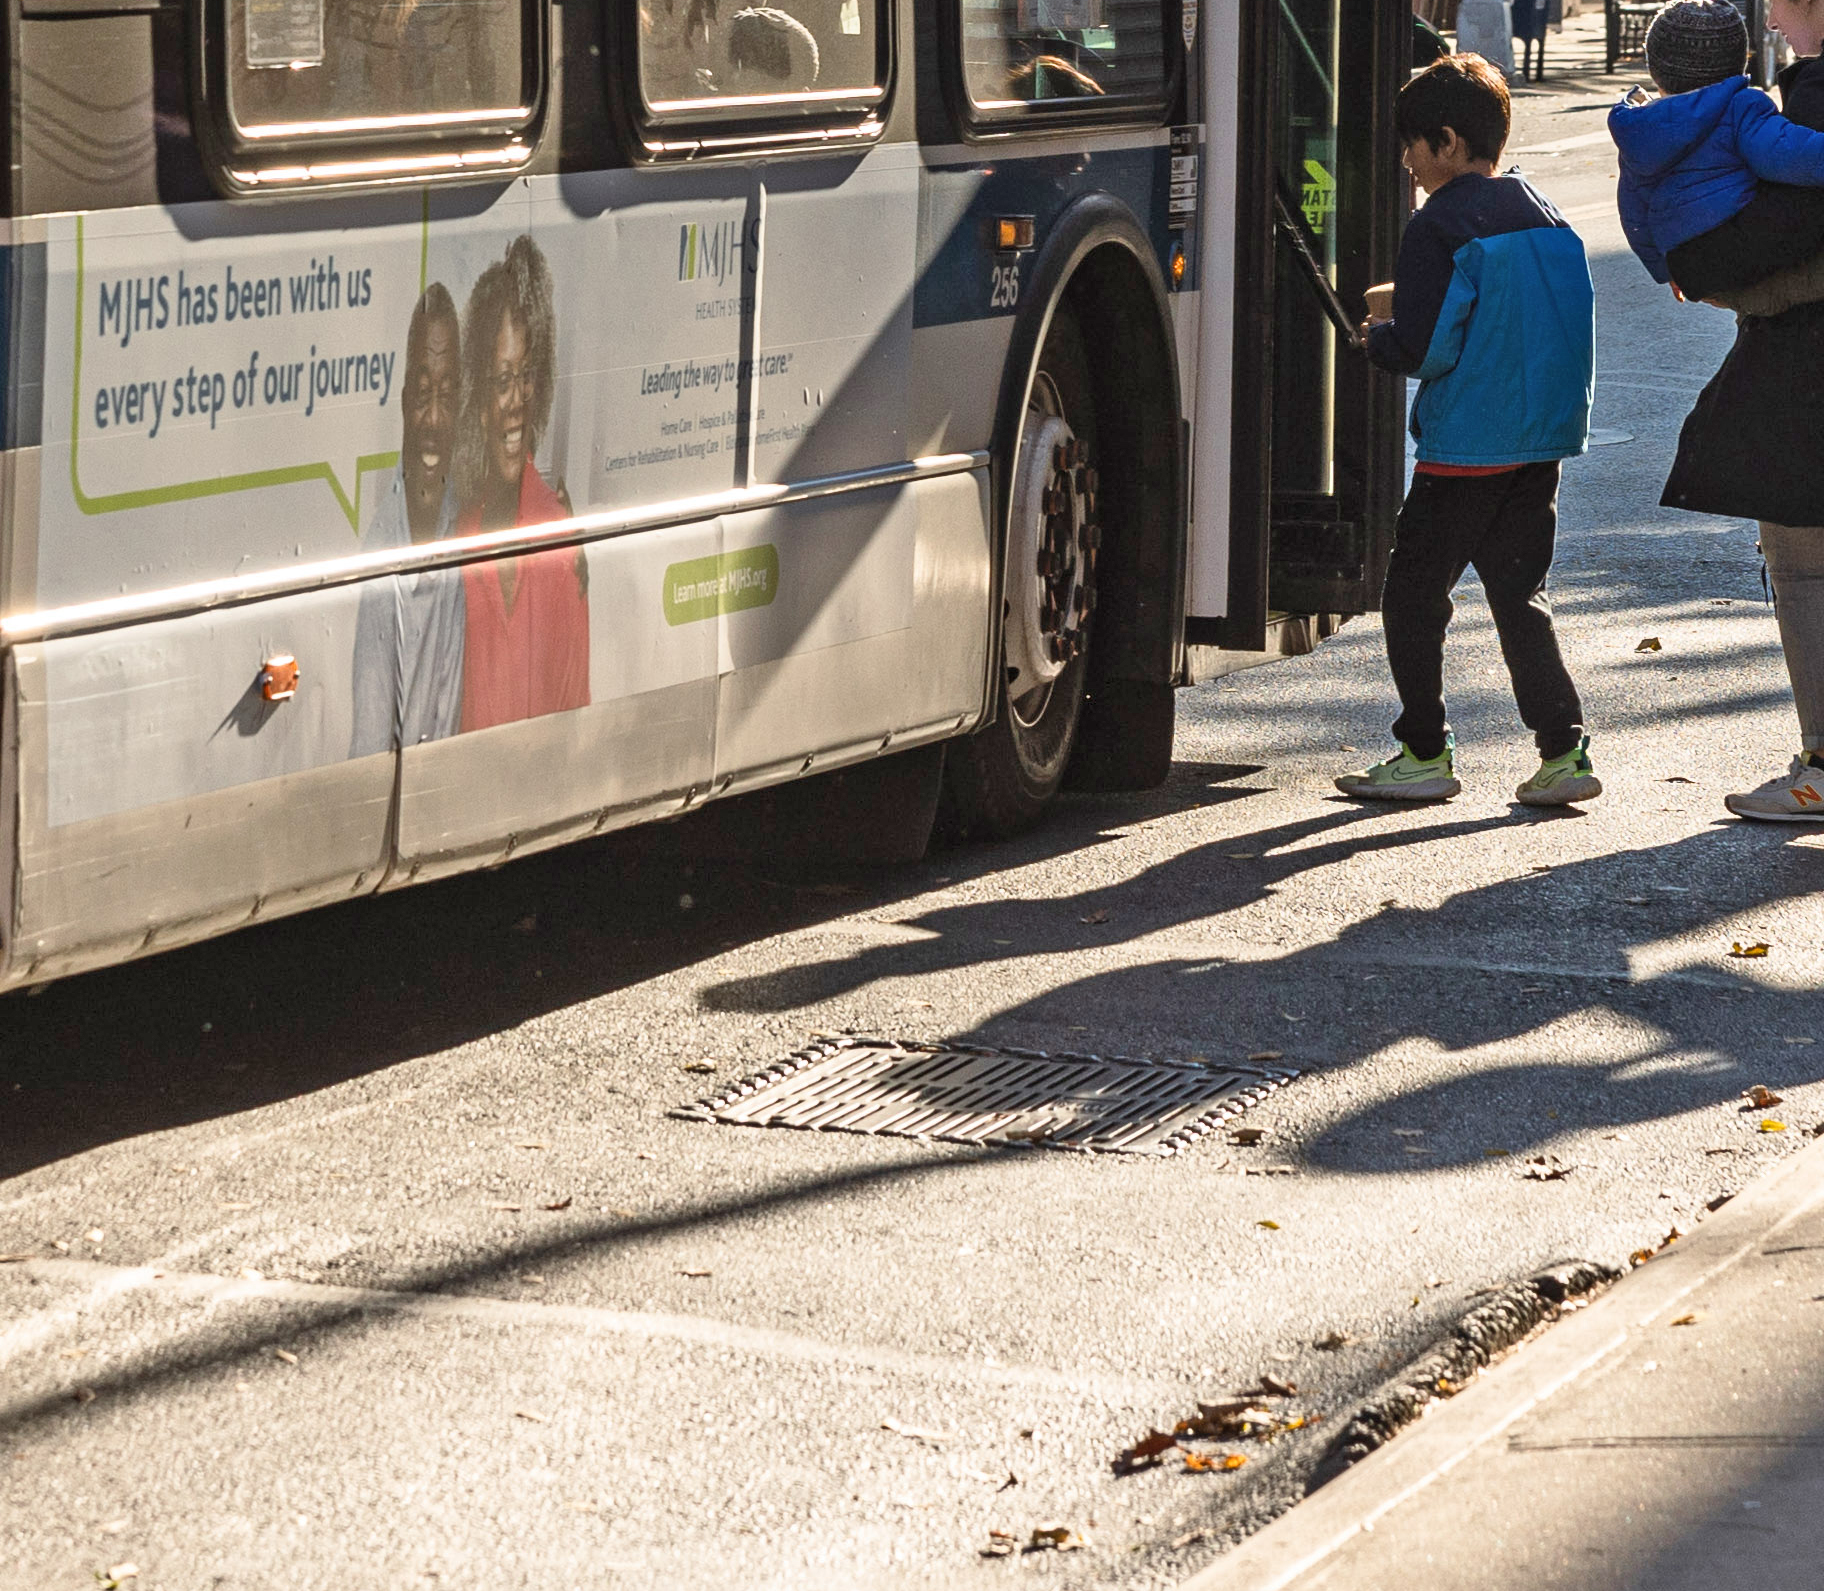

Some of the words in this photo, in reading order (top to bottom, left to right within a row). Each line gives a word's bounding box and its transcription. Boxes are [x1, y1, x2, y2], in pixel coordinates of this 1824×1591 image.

[98, 275, 169, 348] MJHS
[177, 269, 218, 327] has
[225, 265, 282, 321] been
[289, 255, 340, 314] with
[347, 267, 372, 308] us
[990, 265, 1019, 307] 256
[696, 301, 726, 321] HEALTH
[728, 296, 755, 317] SYSTE
[95, 378, 167, 439] every
[172, 365, 226, 431] step
[232, 350, 259, 409] of
[264, 361, 304, 405] our
[305, 345, 396, 417] journey
[640, 363, 682, 399] Leading
[684, 360, 701, 389] the
[702, 365, 722, 393] way
[724, 357, 735, 382] to
[660, 419, 678, 436] Home
[678, 416, 692, 433] Care
[699, 411, 720, 430] Hospice
[606, 452, 627, 471] Centers
[628, 451, 636, 467] for
[638, 446, 677, 466] Rehabilitation
[684, 439, 706, 459] Nursing
[706, 439, 719, 454] Care
[674, 583, 696, 604] Learn
[697, 579, 718, 597] more
[718, 575, 728, 593] at
[728, 567, 767, 596] MJHS.org
[1790, 783, 1823, 808] N
